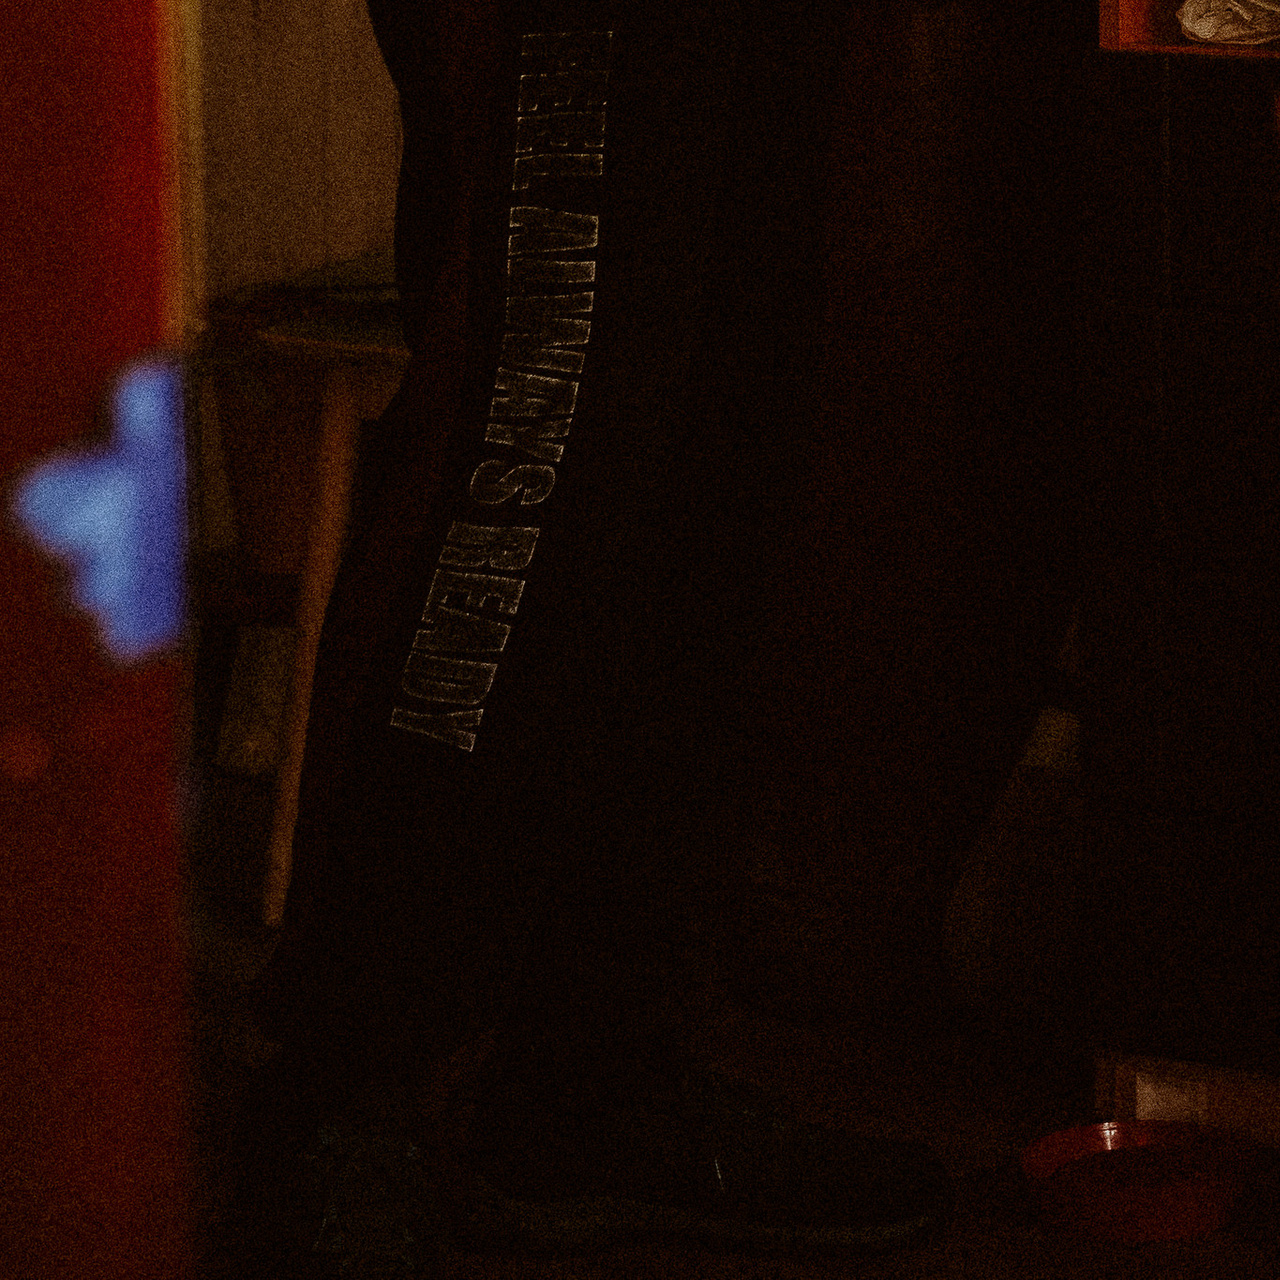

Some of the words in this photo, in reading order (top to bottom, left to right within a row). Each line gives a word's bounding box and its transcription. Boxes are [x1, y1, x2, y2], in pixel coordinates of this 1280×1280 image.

[511, 30, 613, 191] FEEL
[468, 206, 599, 506] ALWAYS
[390, 521, 540, 752] READY
